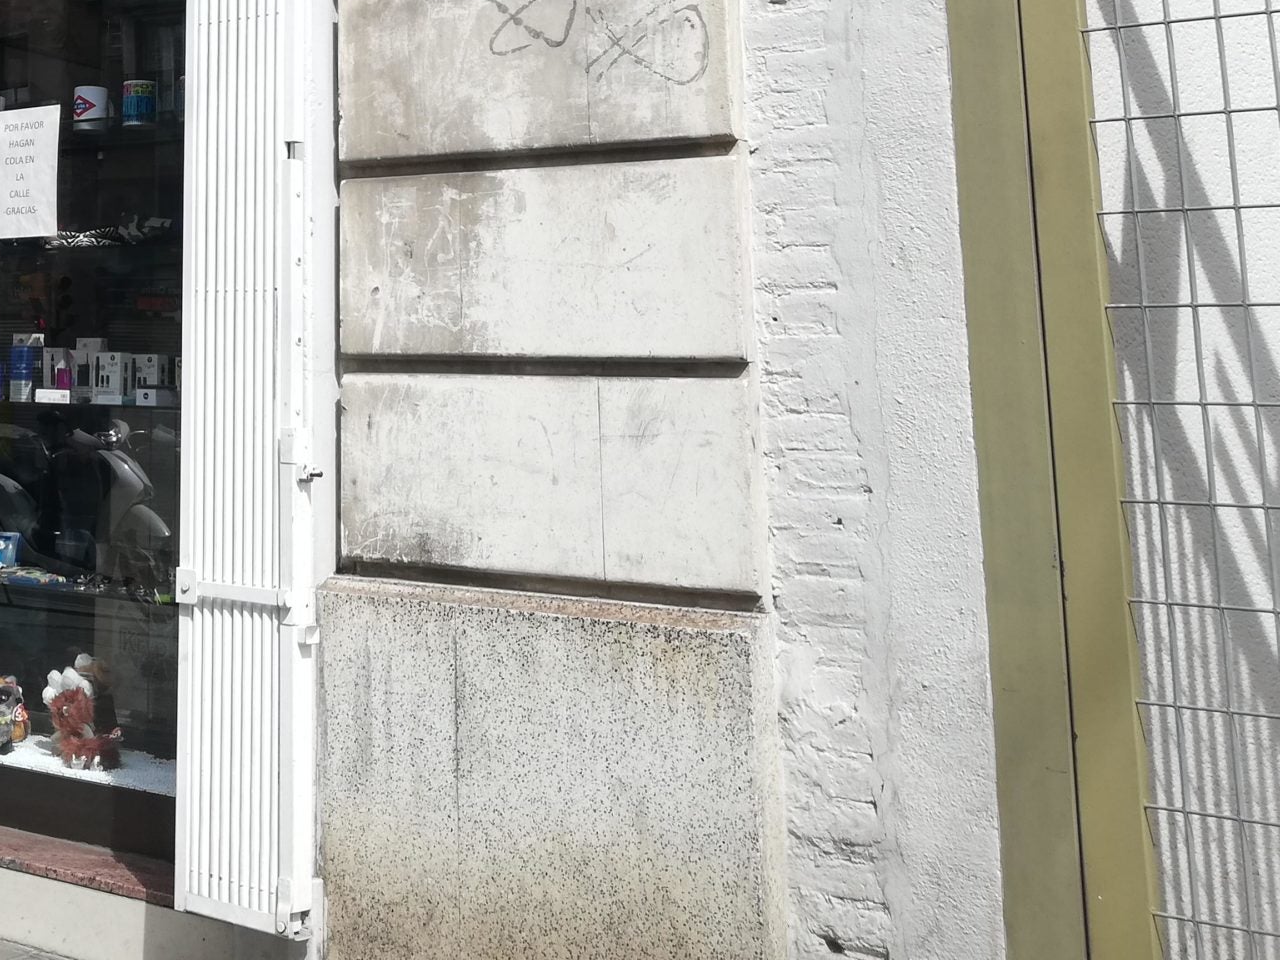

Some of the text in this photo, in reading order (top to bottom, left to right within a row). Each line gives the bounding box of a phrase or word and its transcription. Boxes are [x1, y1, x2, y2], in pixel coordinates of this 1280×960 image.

[4, 121, 44, 132] POR FAVOR
[8, 139, 35, 148] HAGAN
[4, 155, 35, 166] COLA EN
[15, 173, 24, 181] LA
[9, 189, 30, 198] CALLE
